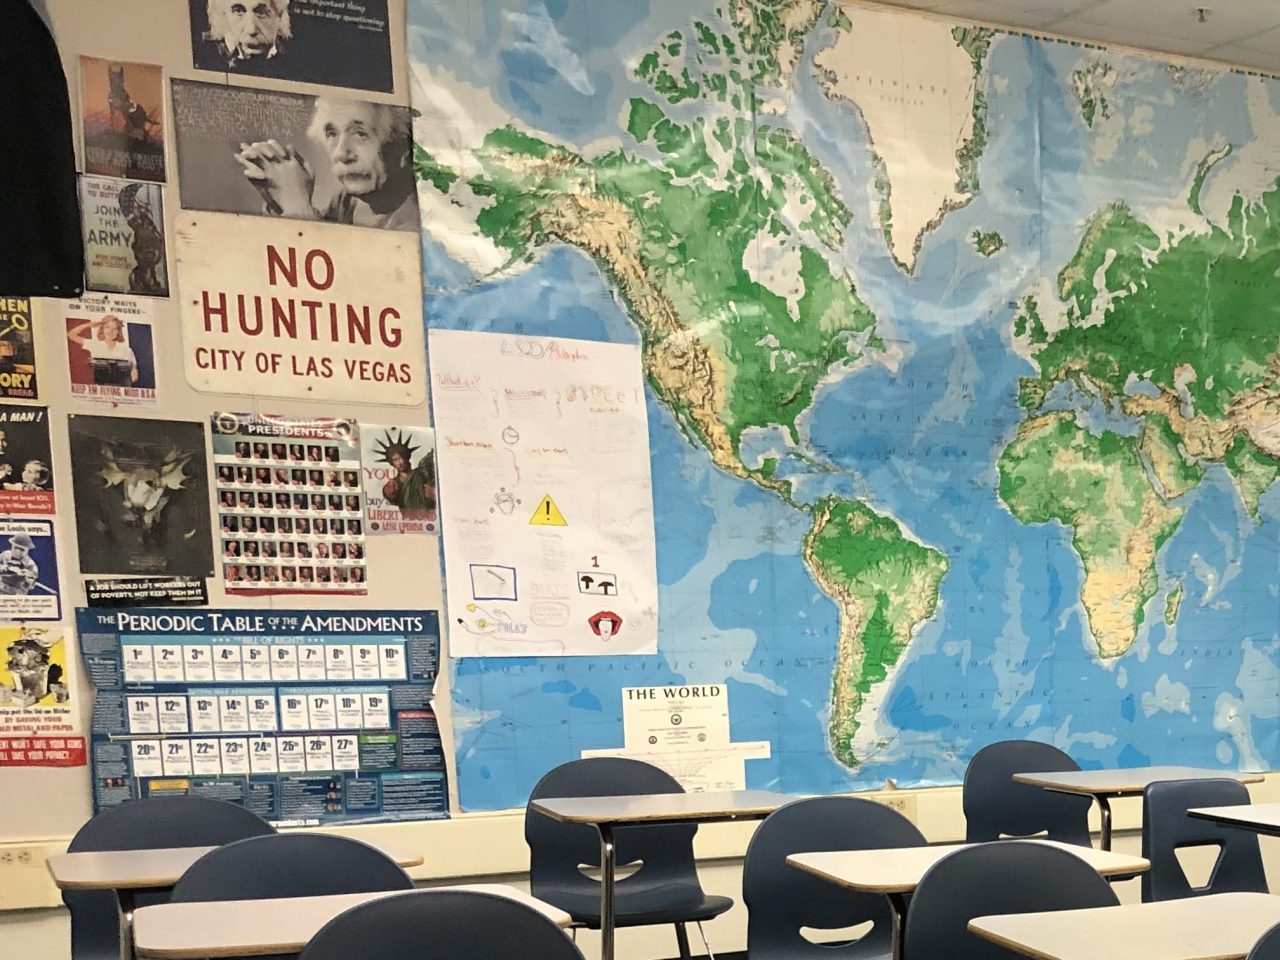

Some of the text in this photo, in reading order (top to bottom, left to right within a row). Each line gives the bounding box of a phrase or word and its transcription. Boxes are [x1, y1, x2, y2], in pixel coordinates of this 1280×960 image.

[94, 204, 121, 216] JOIN
[99, 218, 119, 228] THE
[87, 229, 132, 248] ARMY
[266, 244, 335, 291] NO
[202, 290, 402, 348] HUNTING
[195, 347, 412, 384] CITY OF LAS VEGAS
[248, 425, 325, 438] PRESIDENTS
[363, 468, 396, 480] YOU
[365, 491, 385, 508] buy
[111, 583, 138, 591] SHOULD
[134, 590, 149, 598] NOT
[97, 612, 423, 632] THE PERIODIC TABLE OF THE AMENDMENTS
[626, 685, 720, 701] THE WORLD
